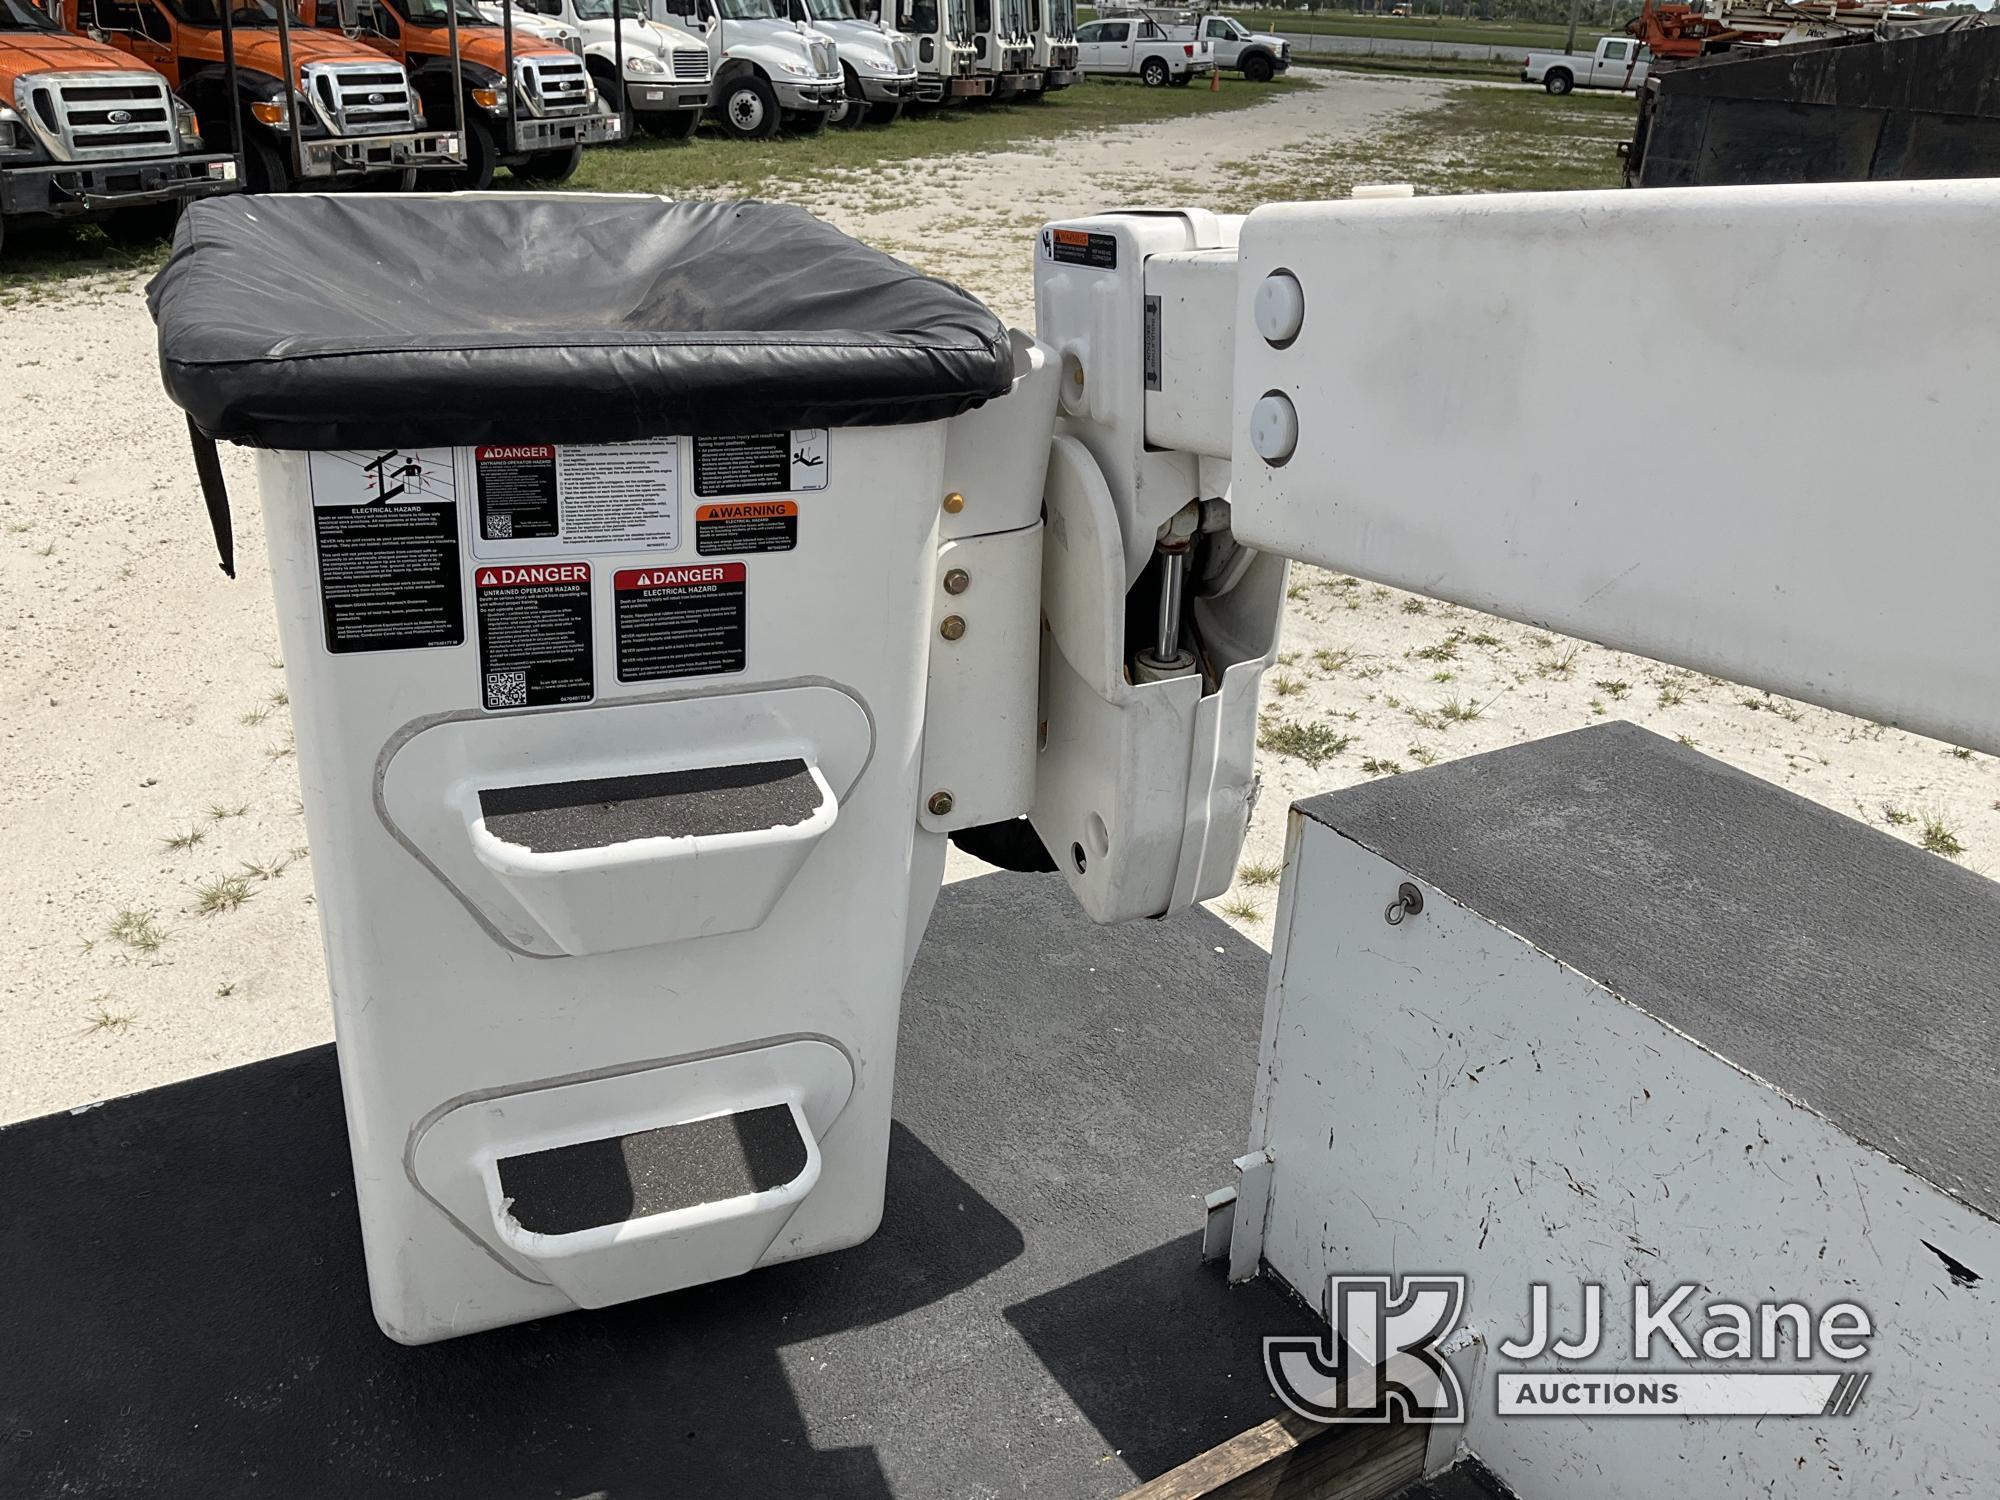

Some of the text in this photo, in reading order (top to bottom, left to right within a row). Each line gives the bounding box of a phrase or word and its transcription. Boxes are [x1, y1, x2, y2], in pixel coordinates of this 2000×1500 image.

[495, 447, 548, 458] DANGER
[720, 504, 785, 518] WARNING
[502, 566, 588, 584] DANGER
[654, 568, 724, 584] DANGER
[643, 585, 717, 597] ELECTRICAL HAZARD
